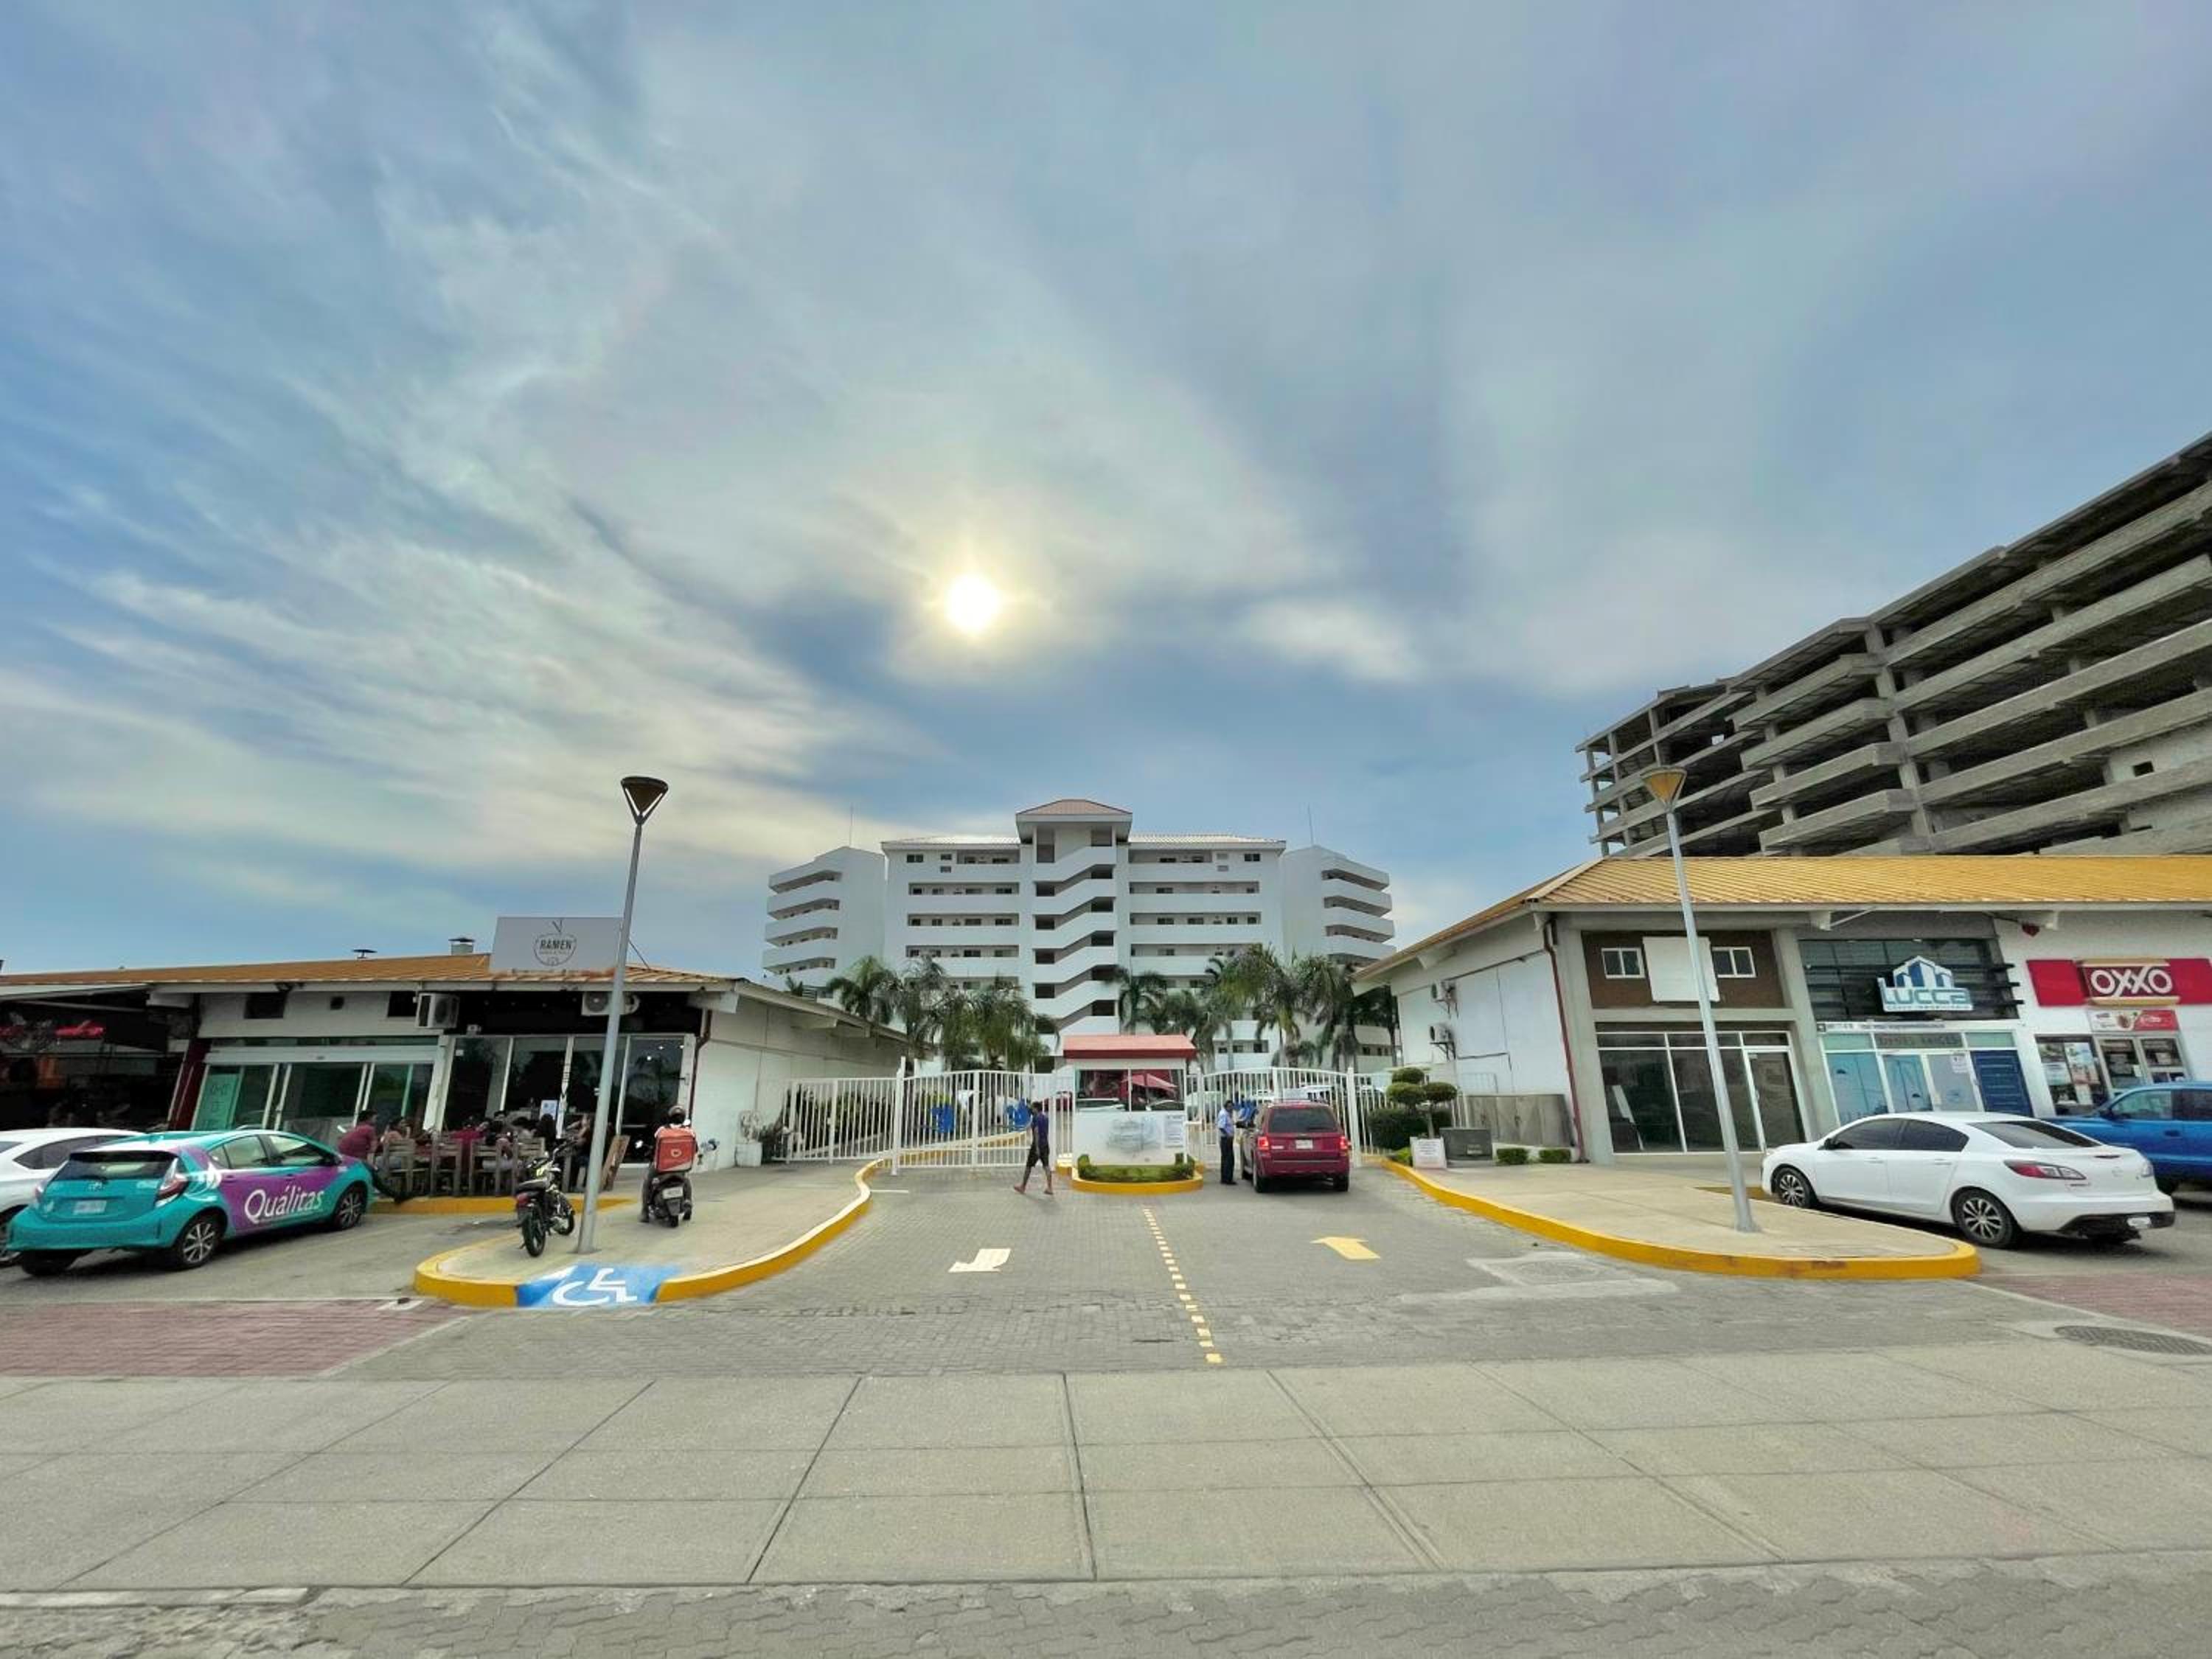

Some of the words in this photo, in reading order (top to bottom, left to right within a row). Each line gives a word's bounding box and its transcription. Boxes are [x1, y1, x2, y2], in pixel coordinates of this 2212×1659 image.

[540, 939, 572, 950] RAMEN
[2090, 966, 2174, 998] OXXO
[244, 1184, 324, 1224] Quálitas
